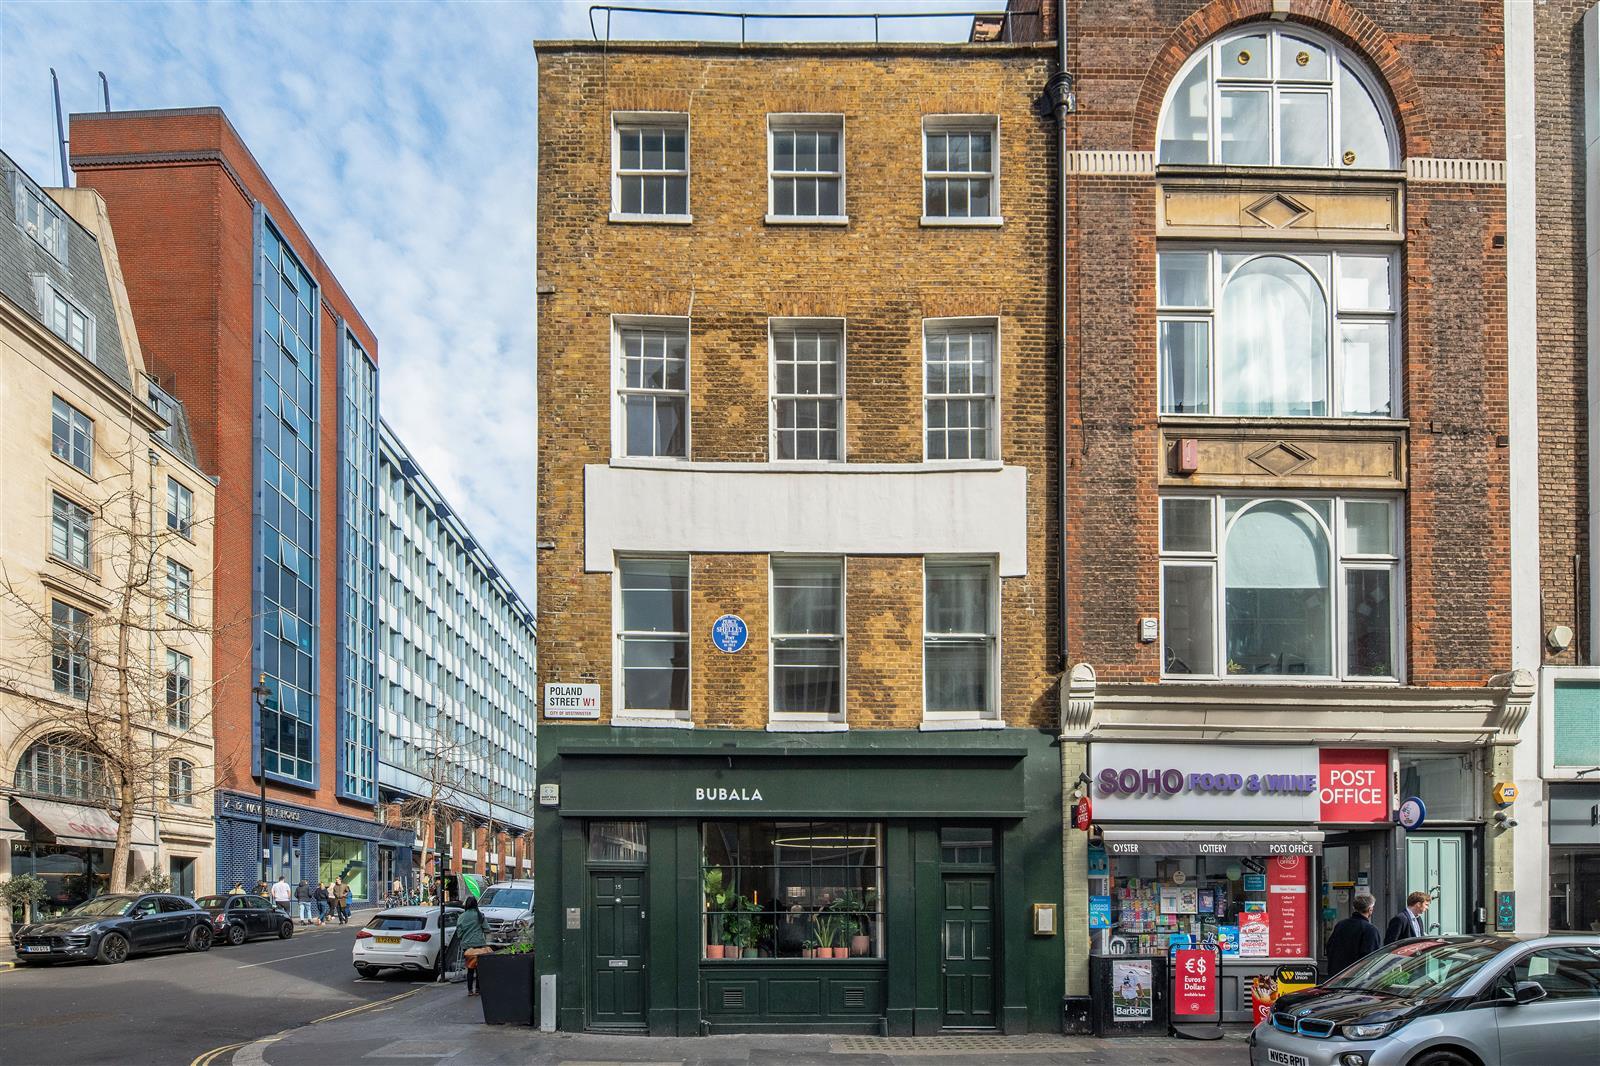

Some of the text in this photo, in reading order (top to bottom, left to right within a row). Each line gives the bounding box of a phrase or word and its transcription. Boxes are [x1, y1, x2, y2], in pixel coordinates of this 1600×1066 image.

[550, 686, 582, 696] POLAND
[549, 697, 595, 706] STREET W1
[1099, 768, 1317, 794] SOHO FOOD & WINE
[1330, 770, 1375, 786] POST
[696, 788, 763, 801] BUBALA
[1320, 788, 1382, 804] OFFICE
[1113, 843, 1313, 853] OYSTER LOTTERY POST OFFICE
[1502, 895, 1510, 903] 14
[1116, 1007, 1148, 1015] Barbour
[1270, 1050, 1289, 1064] NV65
